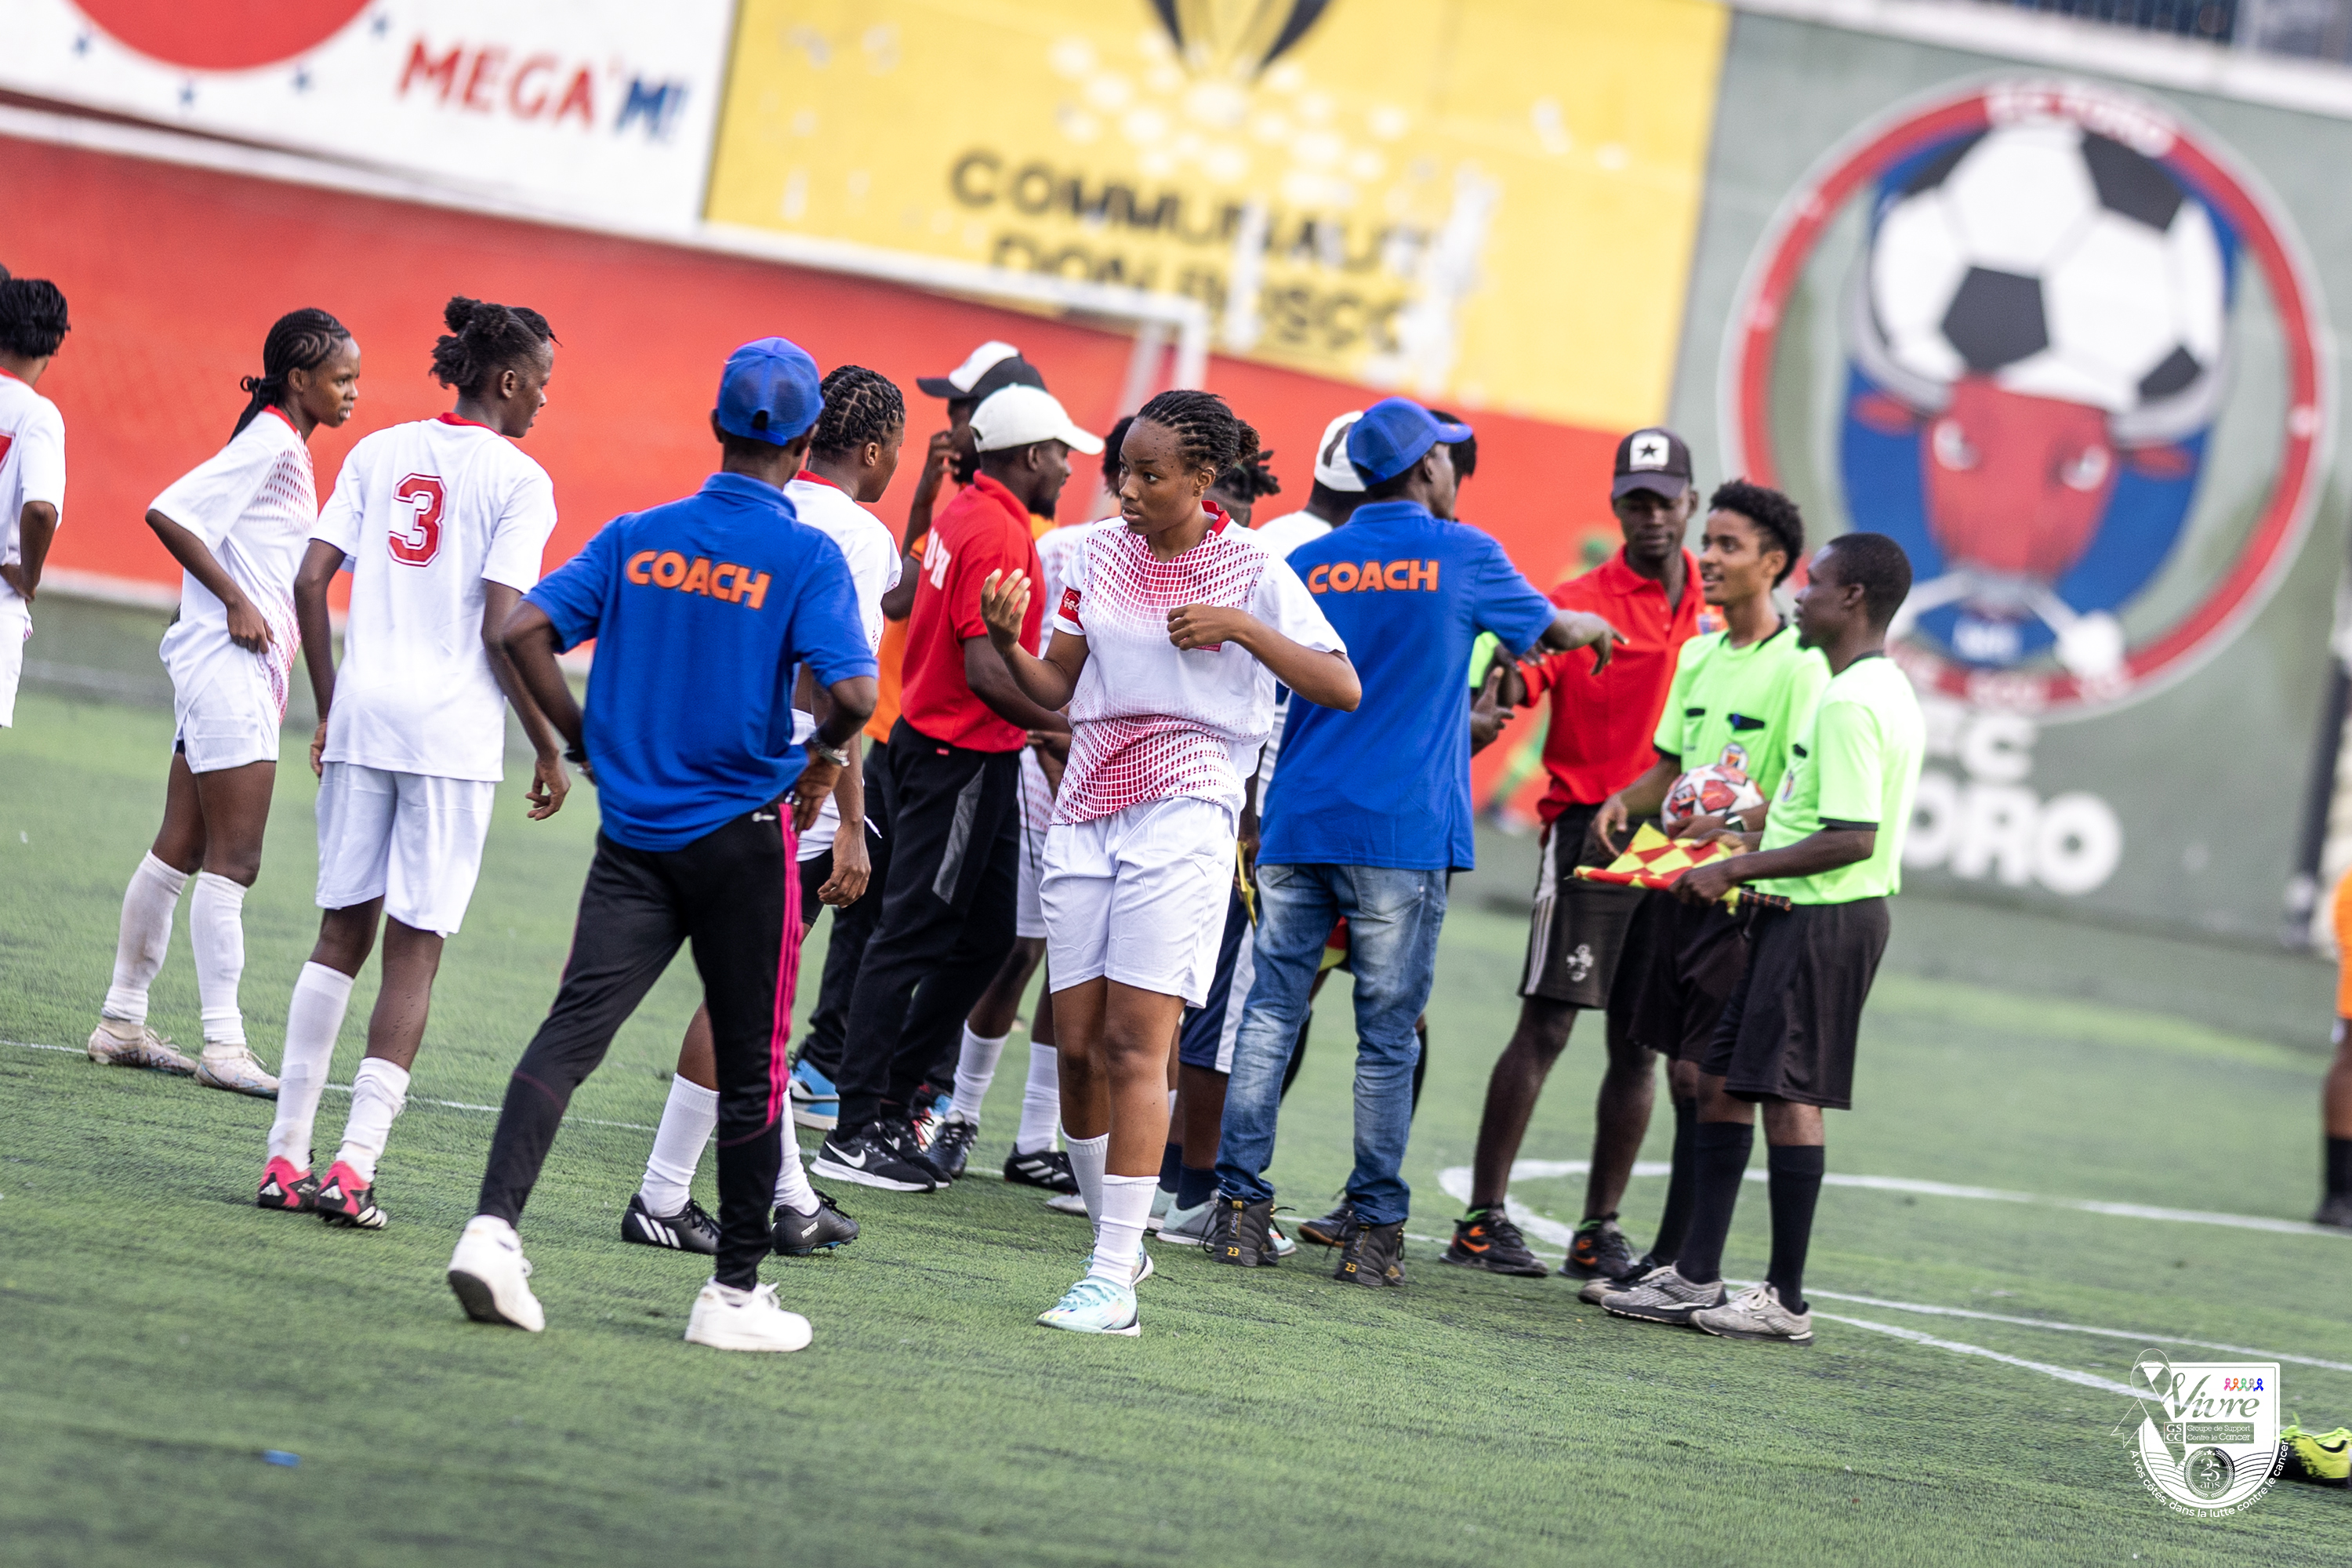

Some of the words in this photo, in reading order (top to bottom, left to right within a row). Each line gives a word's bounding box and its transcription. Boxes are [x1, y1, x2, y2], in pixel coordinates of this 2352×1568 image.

[387, 473, 447, 568] 3
[624, 549, 772, 611] COACH
[1307, 559, 1439, 594] COACH
[1901, 771, 2125, 897] ORO
[1227, 1247, 1240, 1257] 23
[1345, 1262, 1357, 1273] 23
